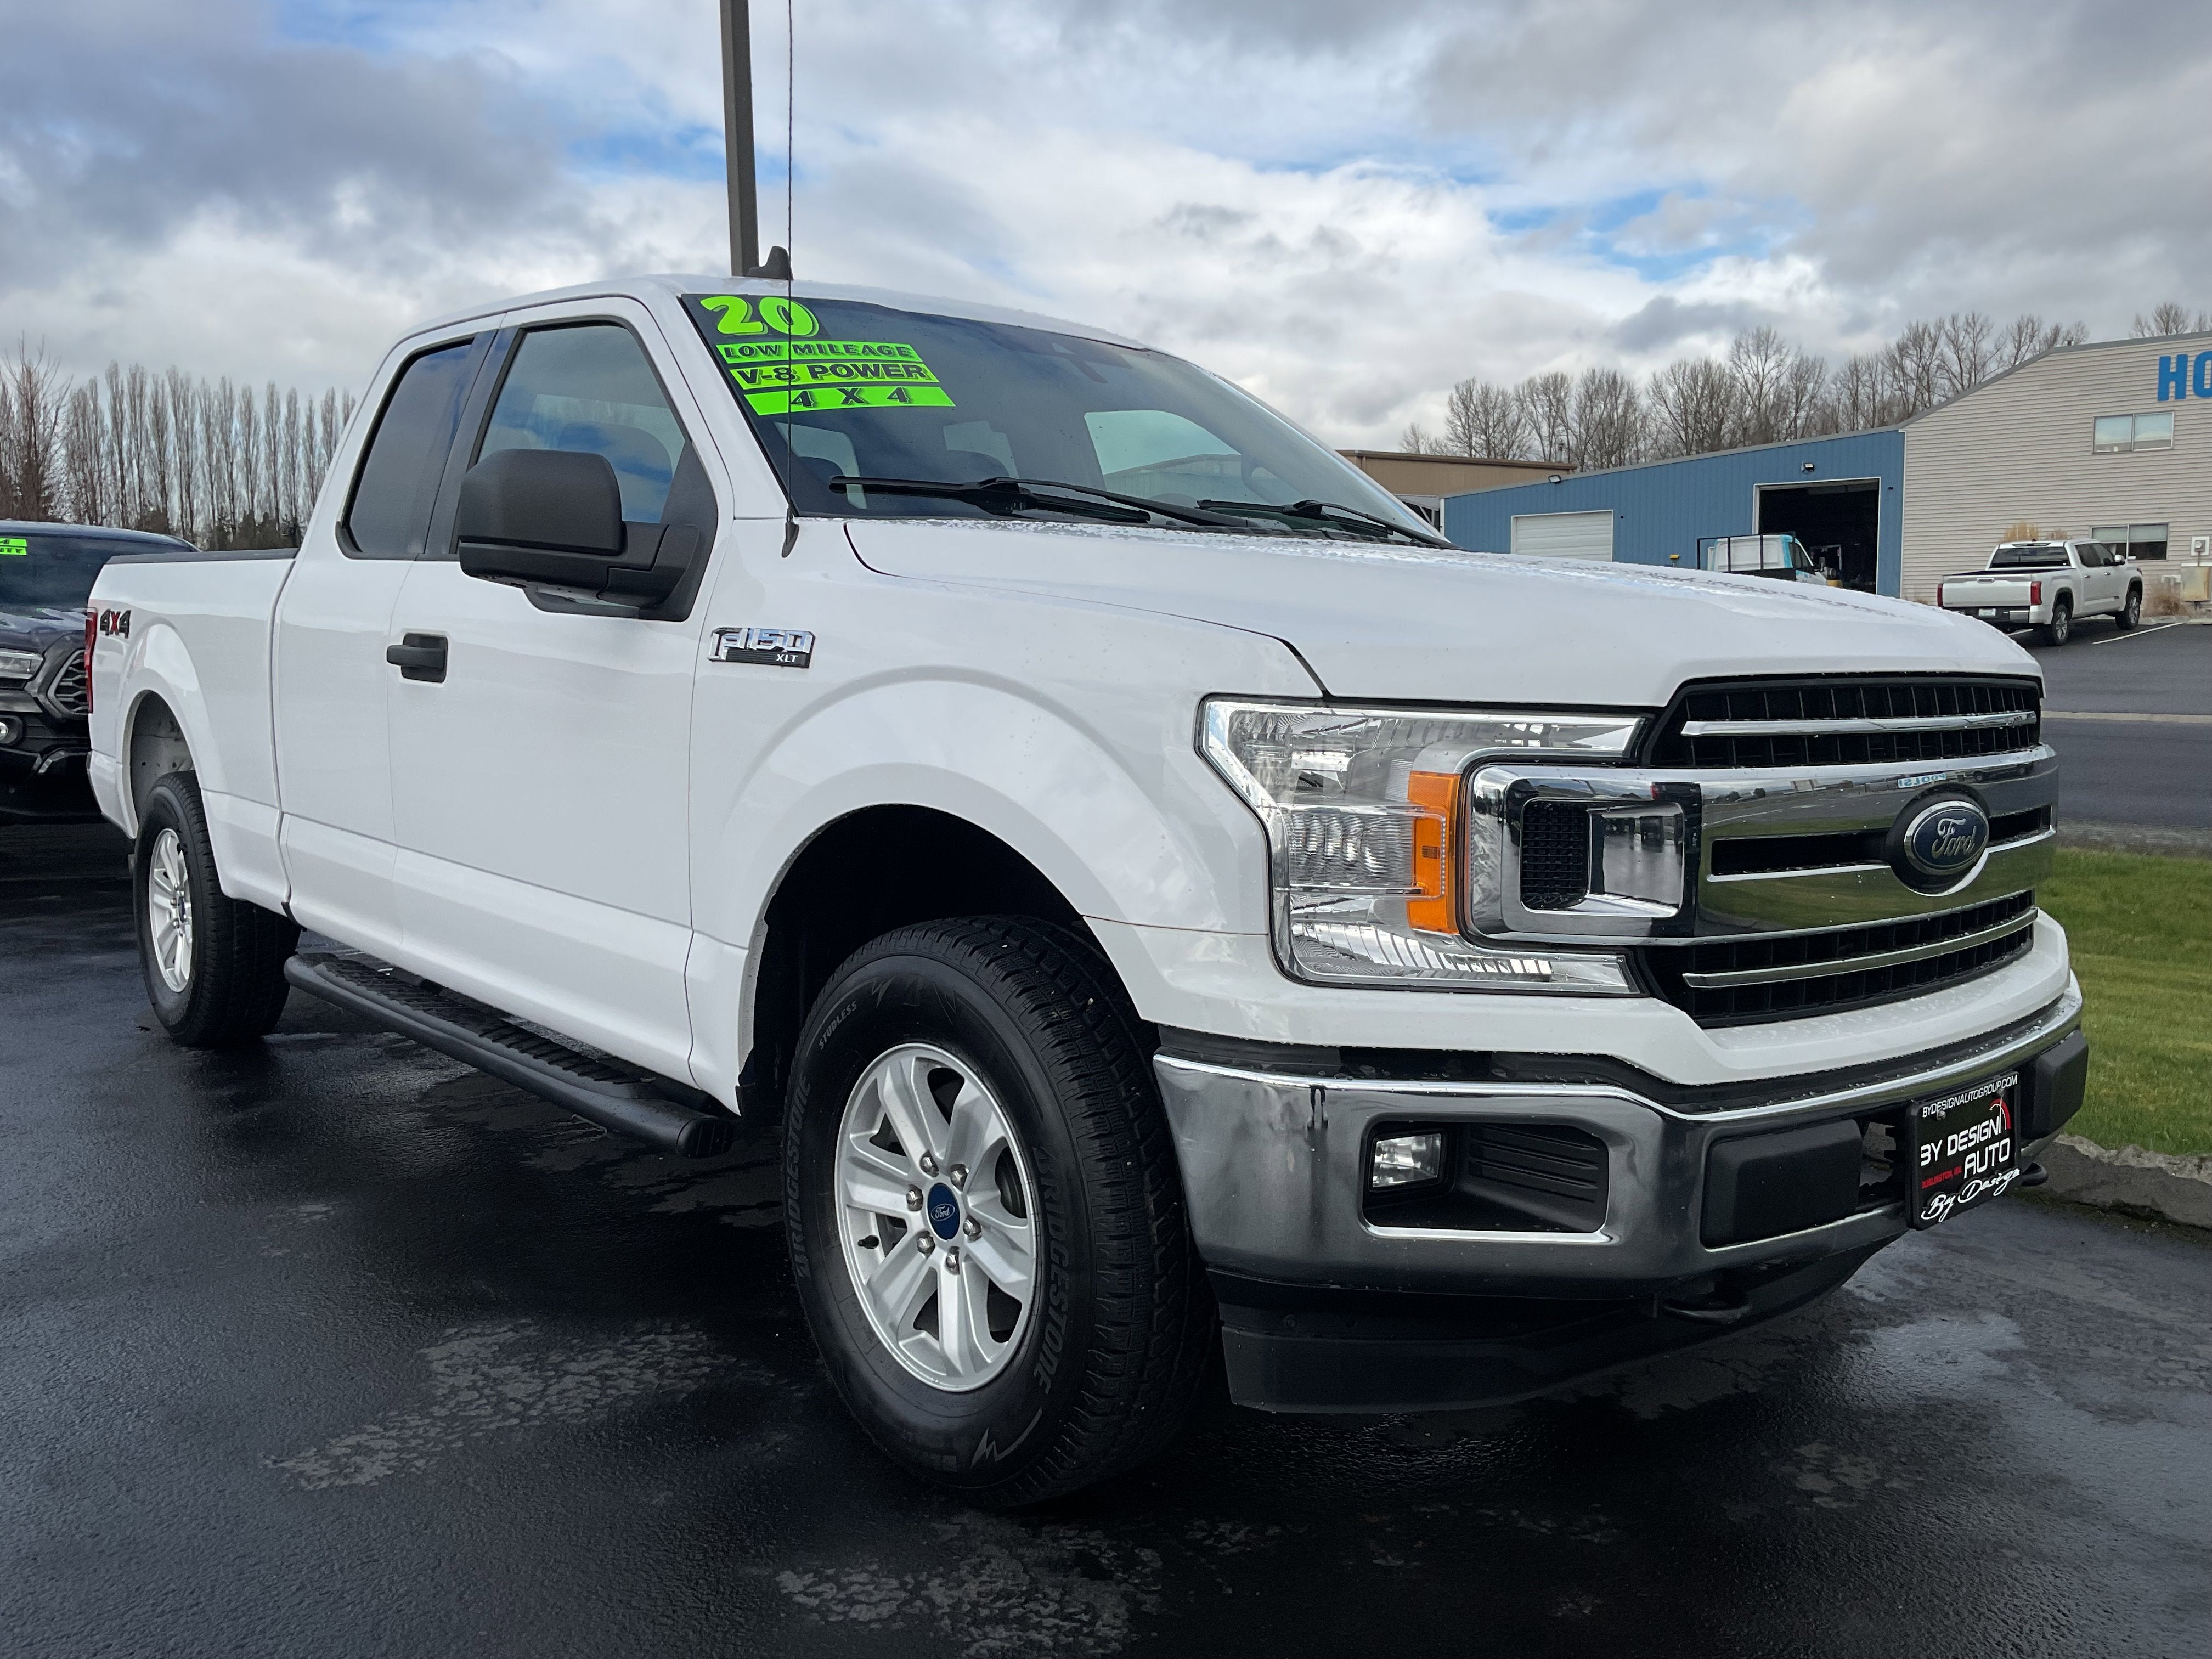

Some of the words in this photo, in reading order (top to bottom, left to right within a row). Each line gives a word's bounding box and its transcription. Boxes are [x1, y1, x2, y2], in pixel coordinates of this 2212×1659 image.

[700, 296, 819, 337] 20
[724, 345, 781, 358] LOW
[793, 344, 911, 358] MILEAGE
[737, 366, 801, 385] V-8
[806, 363, 932, 381] POWER
[2158, 351, 2212, 402] HO
[791, 390, 816, 408] 4
[840, 388, 868, 405] X
[887, 386, 912, 403] 4
[776, 653, 798, 663] XLT
[1931, 818, 1977, 859] Ford
[819, 1000, 857, 1050] STUDLESS
[1921, 1139, 1943, 1166] BY
[1964, 1138, 2010, 1178] AUTO
[787, 1075, 811, 1278] BRIDGESTONE
[1921, 1194, 1956, 1223] By
[1957, 1168, 2020, 1204] Design
[935, 1205, 950, 1219] Ford
